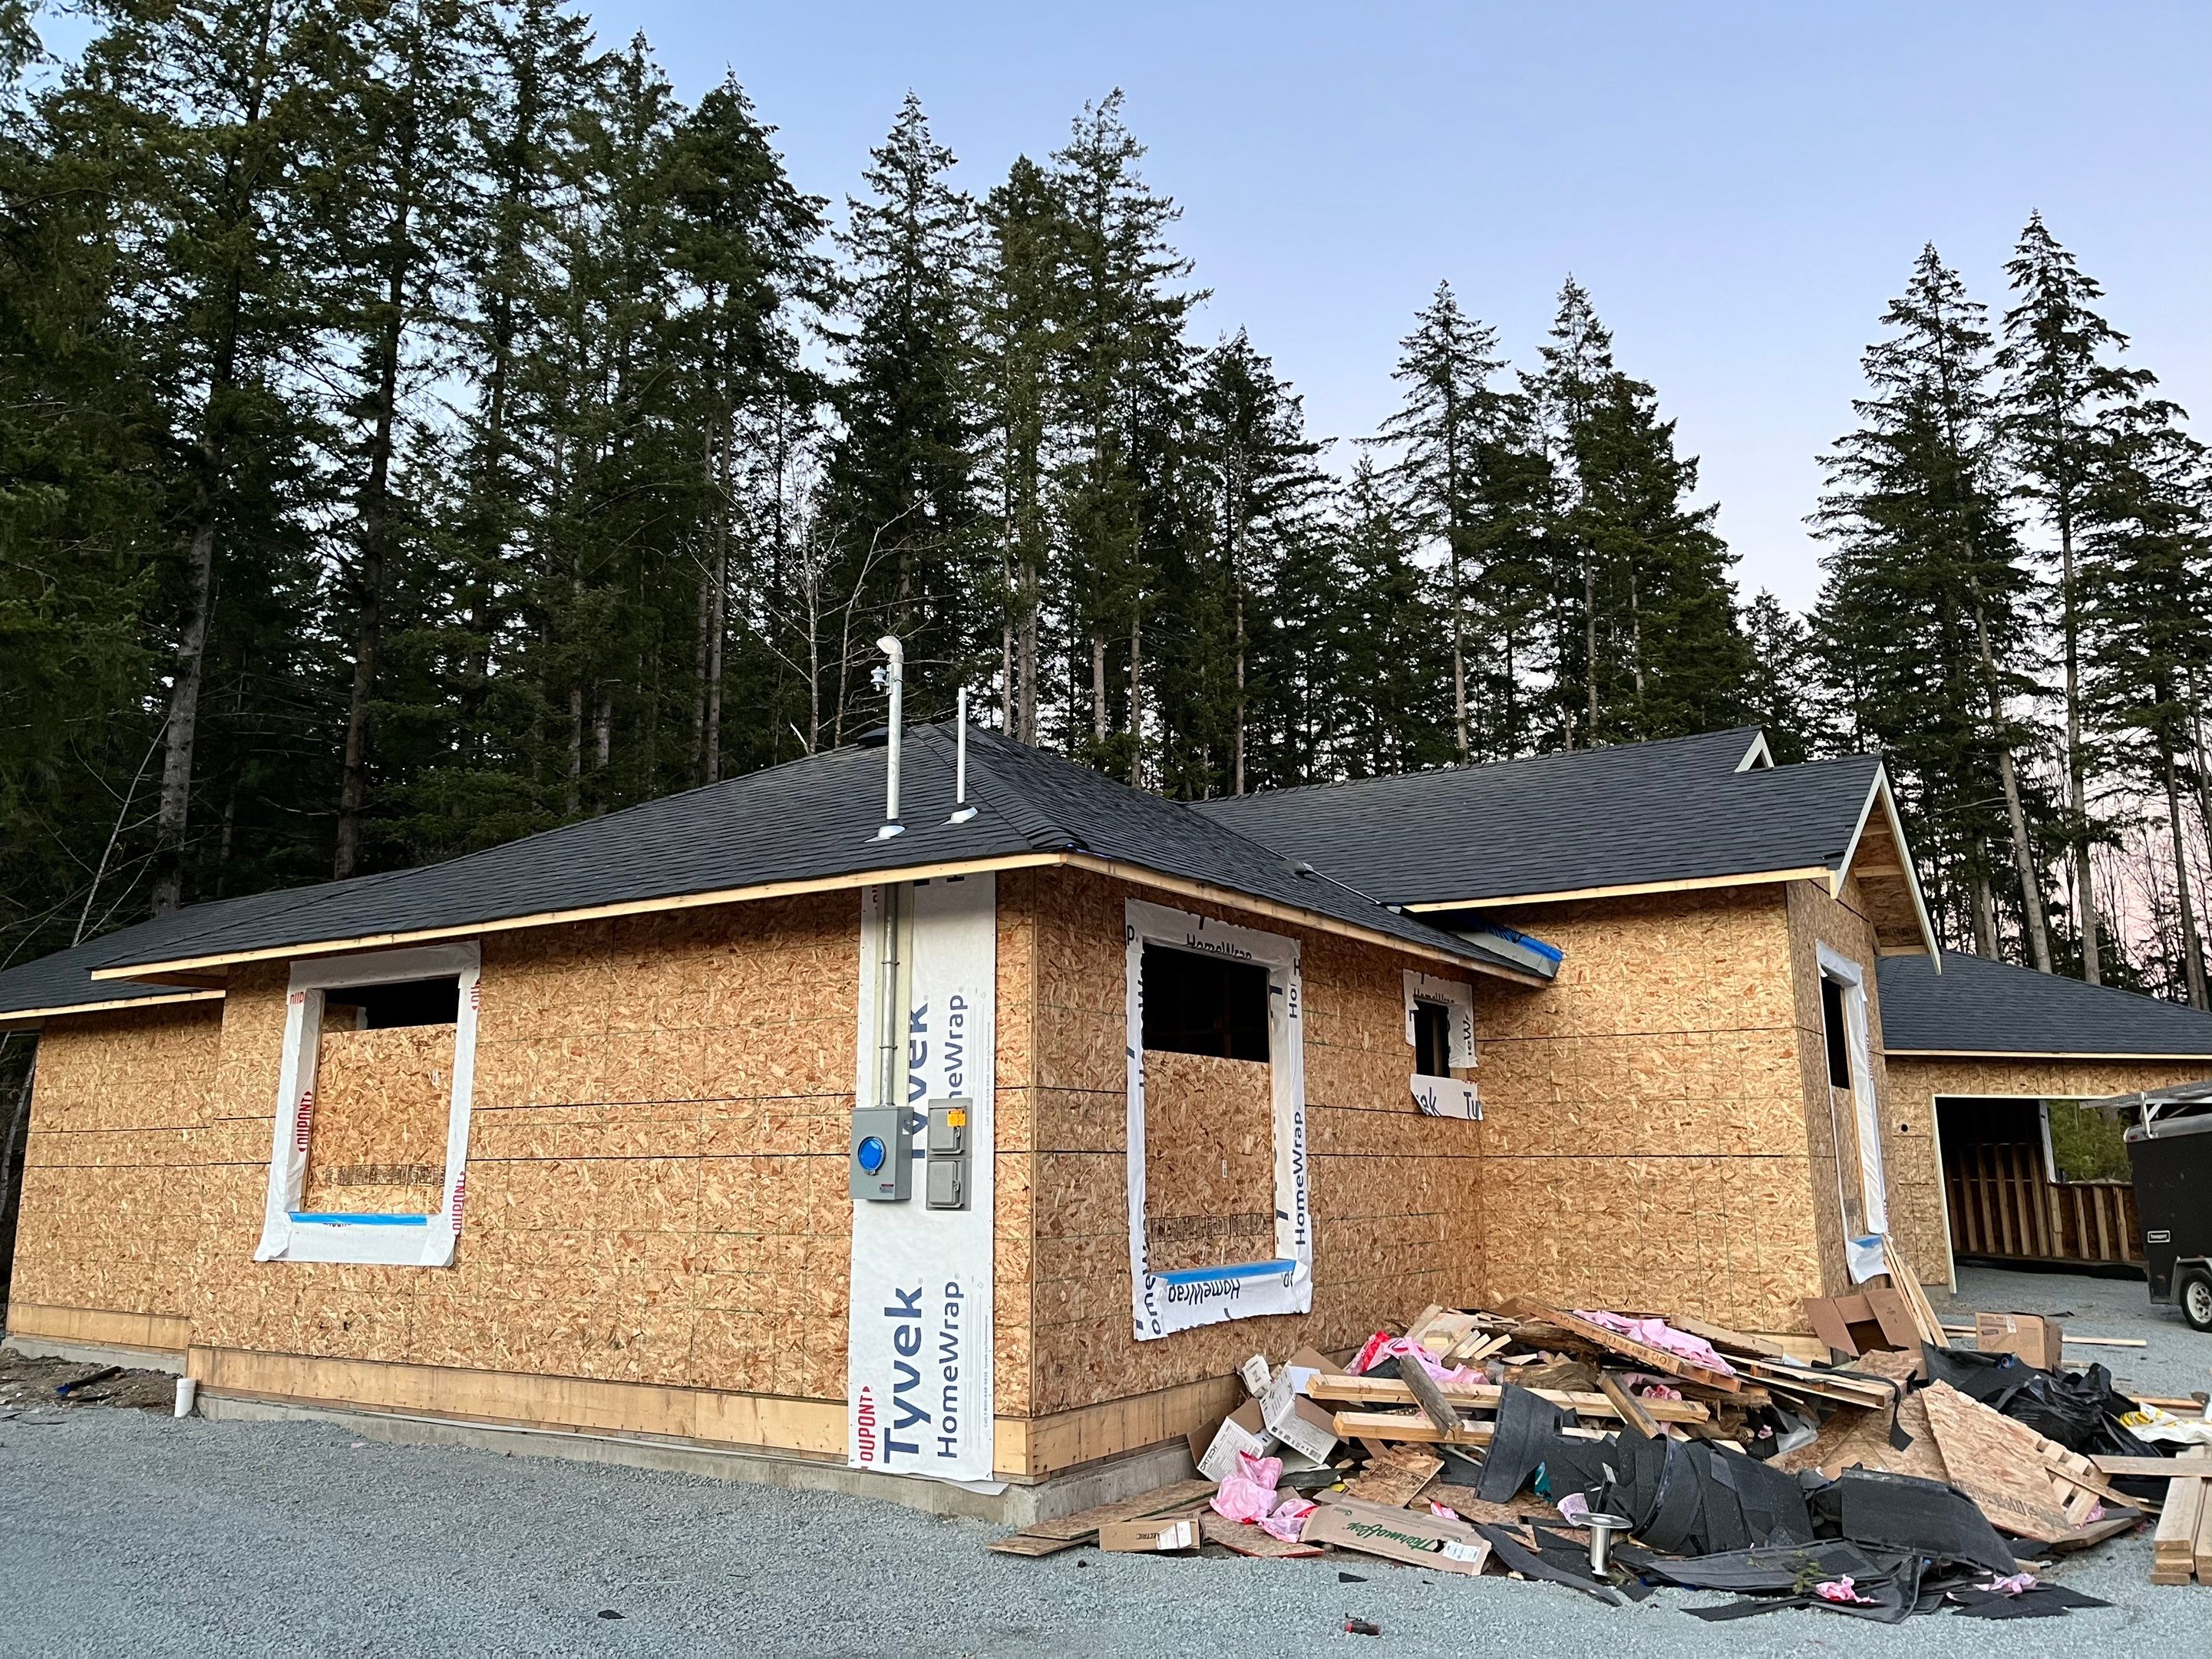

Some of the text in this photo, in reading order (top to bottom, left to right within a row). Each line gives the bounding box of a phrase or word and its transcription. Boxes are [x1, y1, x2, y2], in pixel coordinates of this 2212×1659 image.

[296, 1097, 312, 1144] DUPONT
[1293, 1111, 1306, 1245] HomeWrap
[1167, 1279, 1240, 1305] HomeWrap
[883, 1287, 931, 1463] Tyvek
[937, 1281, 964, 1458] HomeWrap
[858, 1394, 876, 1462] DUPONT
[1346, 1522, 1438, 1553] Thermoflex
